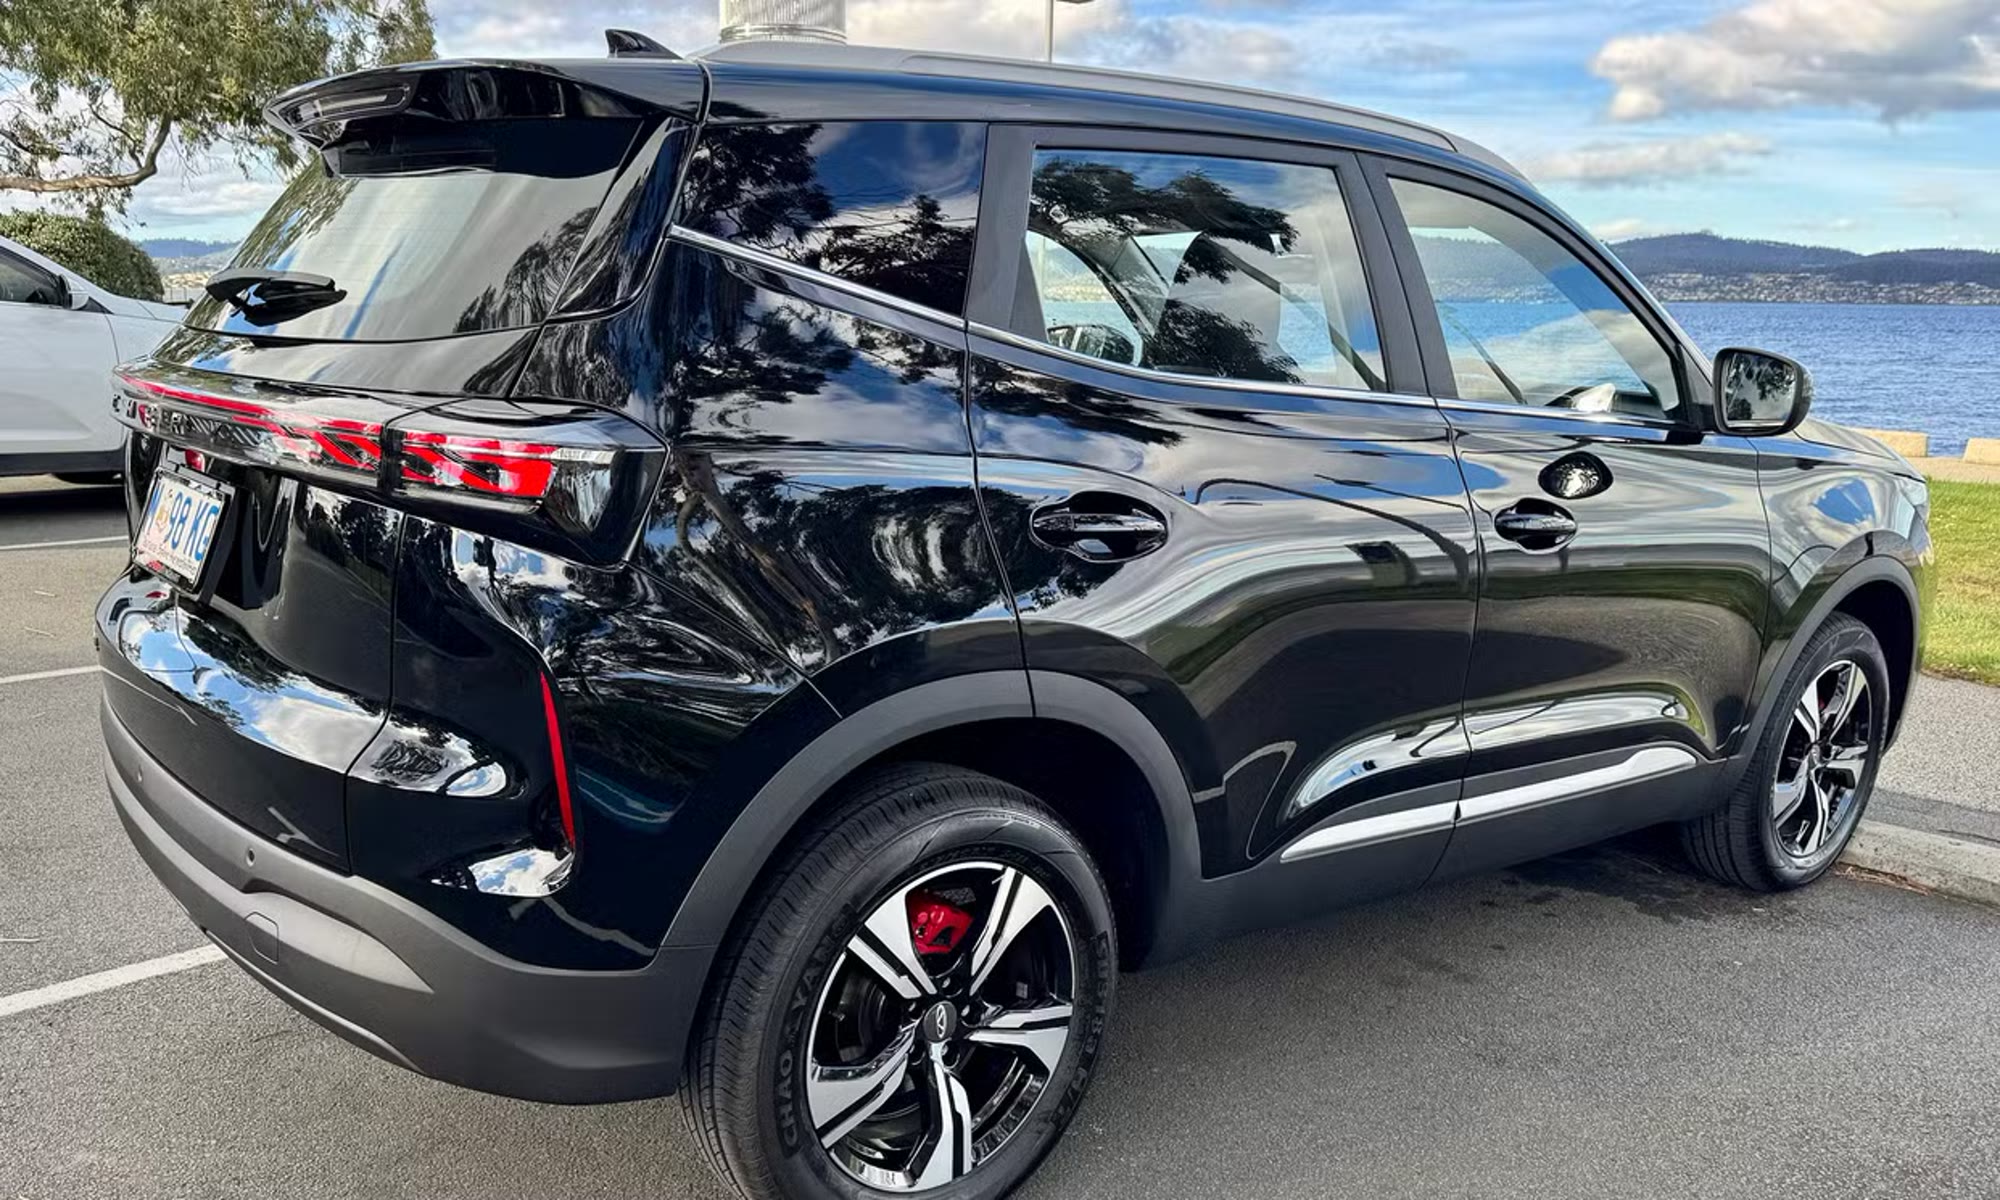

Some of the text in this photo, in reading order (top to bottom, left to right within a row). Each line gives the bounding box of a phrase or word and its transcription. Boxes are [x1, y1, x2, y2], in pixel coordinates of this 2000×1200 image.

[163, 491, 192, 550] 98
[183, 500, 220, 561] KG
[777, 1050, 798, 1147] CHAO
